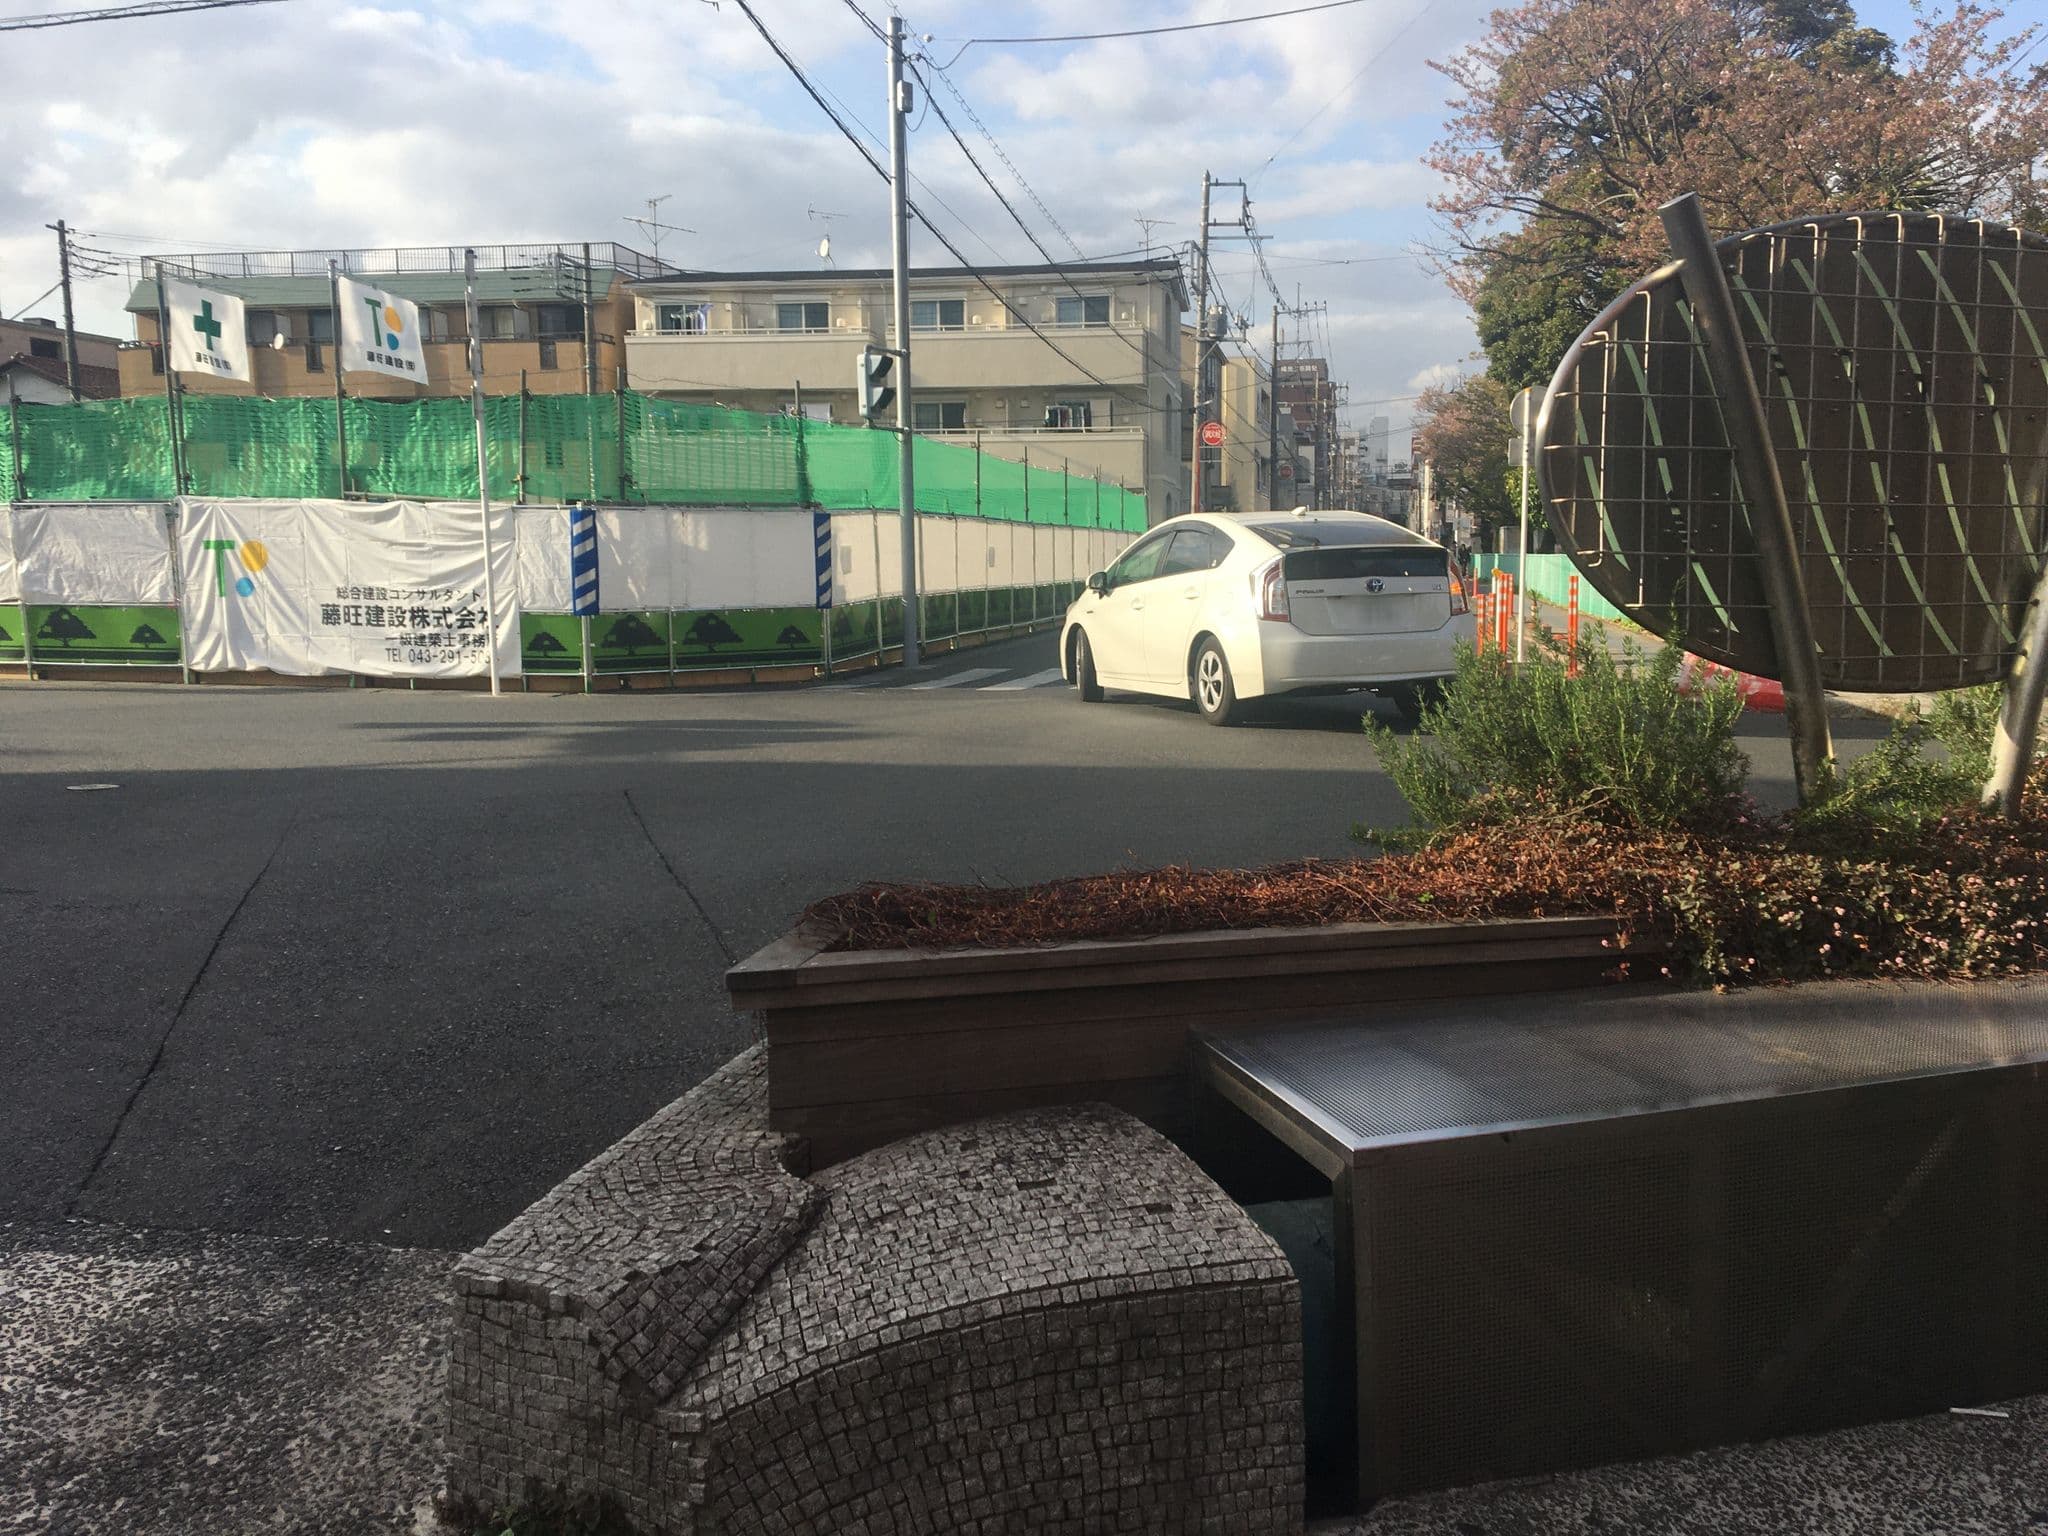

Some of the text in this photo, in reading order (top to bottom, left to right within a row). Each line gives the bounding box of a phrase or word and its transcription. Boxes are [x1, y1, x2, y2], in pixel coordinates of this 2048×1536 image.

[336, 586, 481, 602] 総合建設コンサルタント
